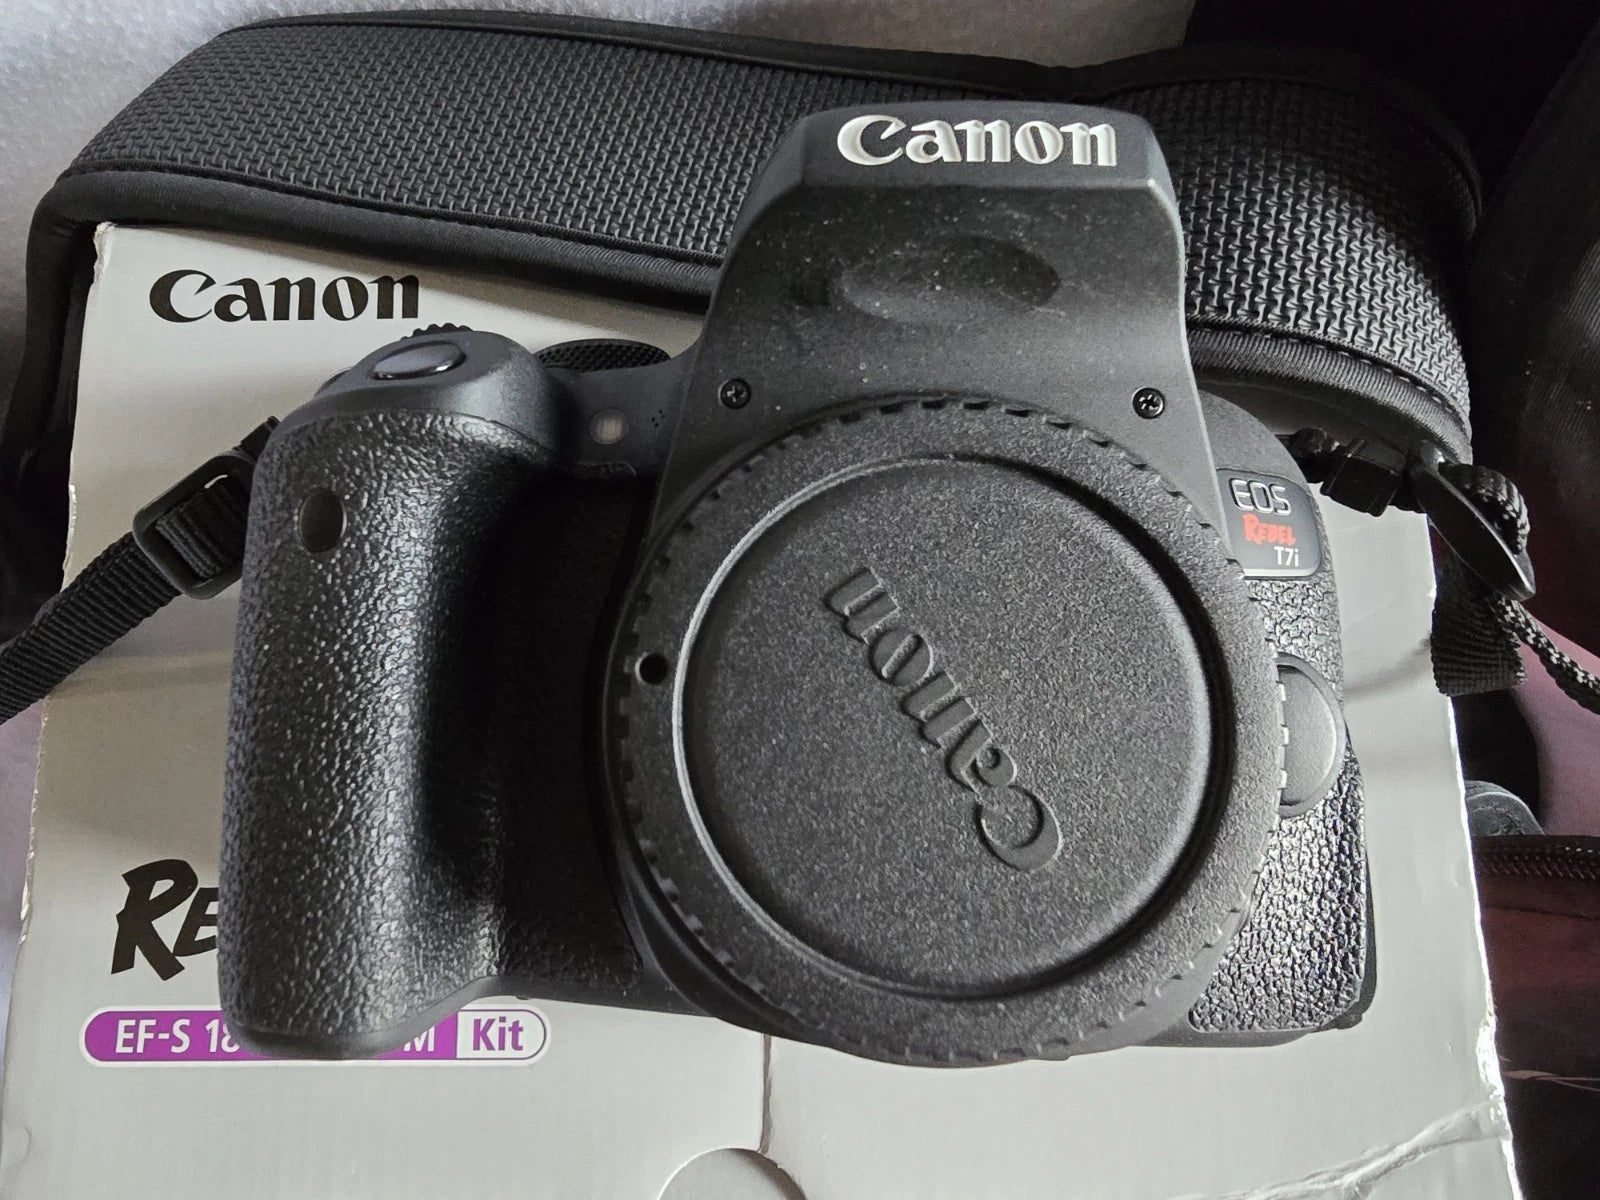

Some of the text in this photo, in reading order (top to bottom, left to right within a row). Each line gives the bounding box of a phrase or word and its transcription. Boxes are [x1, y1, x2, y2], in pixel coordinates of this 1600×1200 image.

[837, 114, 1117, 166] Canon
[150, 269, 419, 322] Canon
[1229, 478, 1291, 516] EOS
[1273, 545, 1299, 567] T7i
[823, 566, 1063, 871] Canon
[112, 858, 217, 981] RE
[115, 1019, 191, 1053] EF-S
[472, 1016, 524, 1051] Kit
